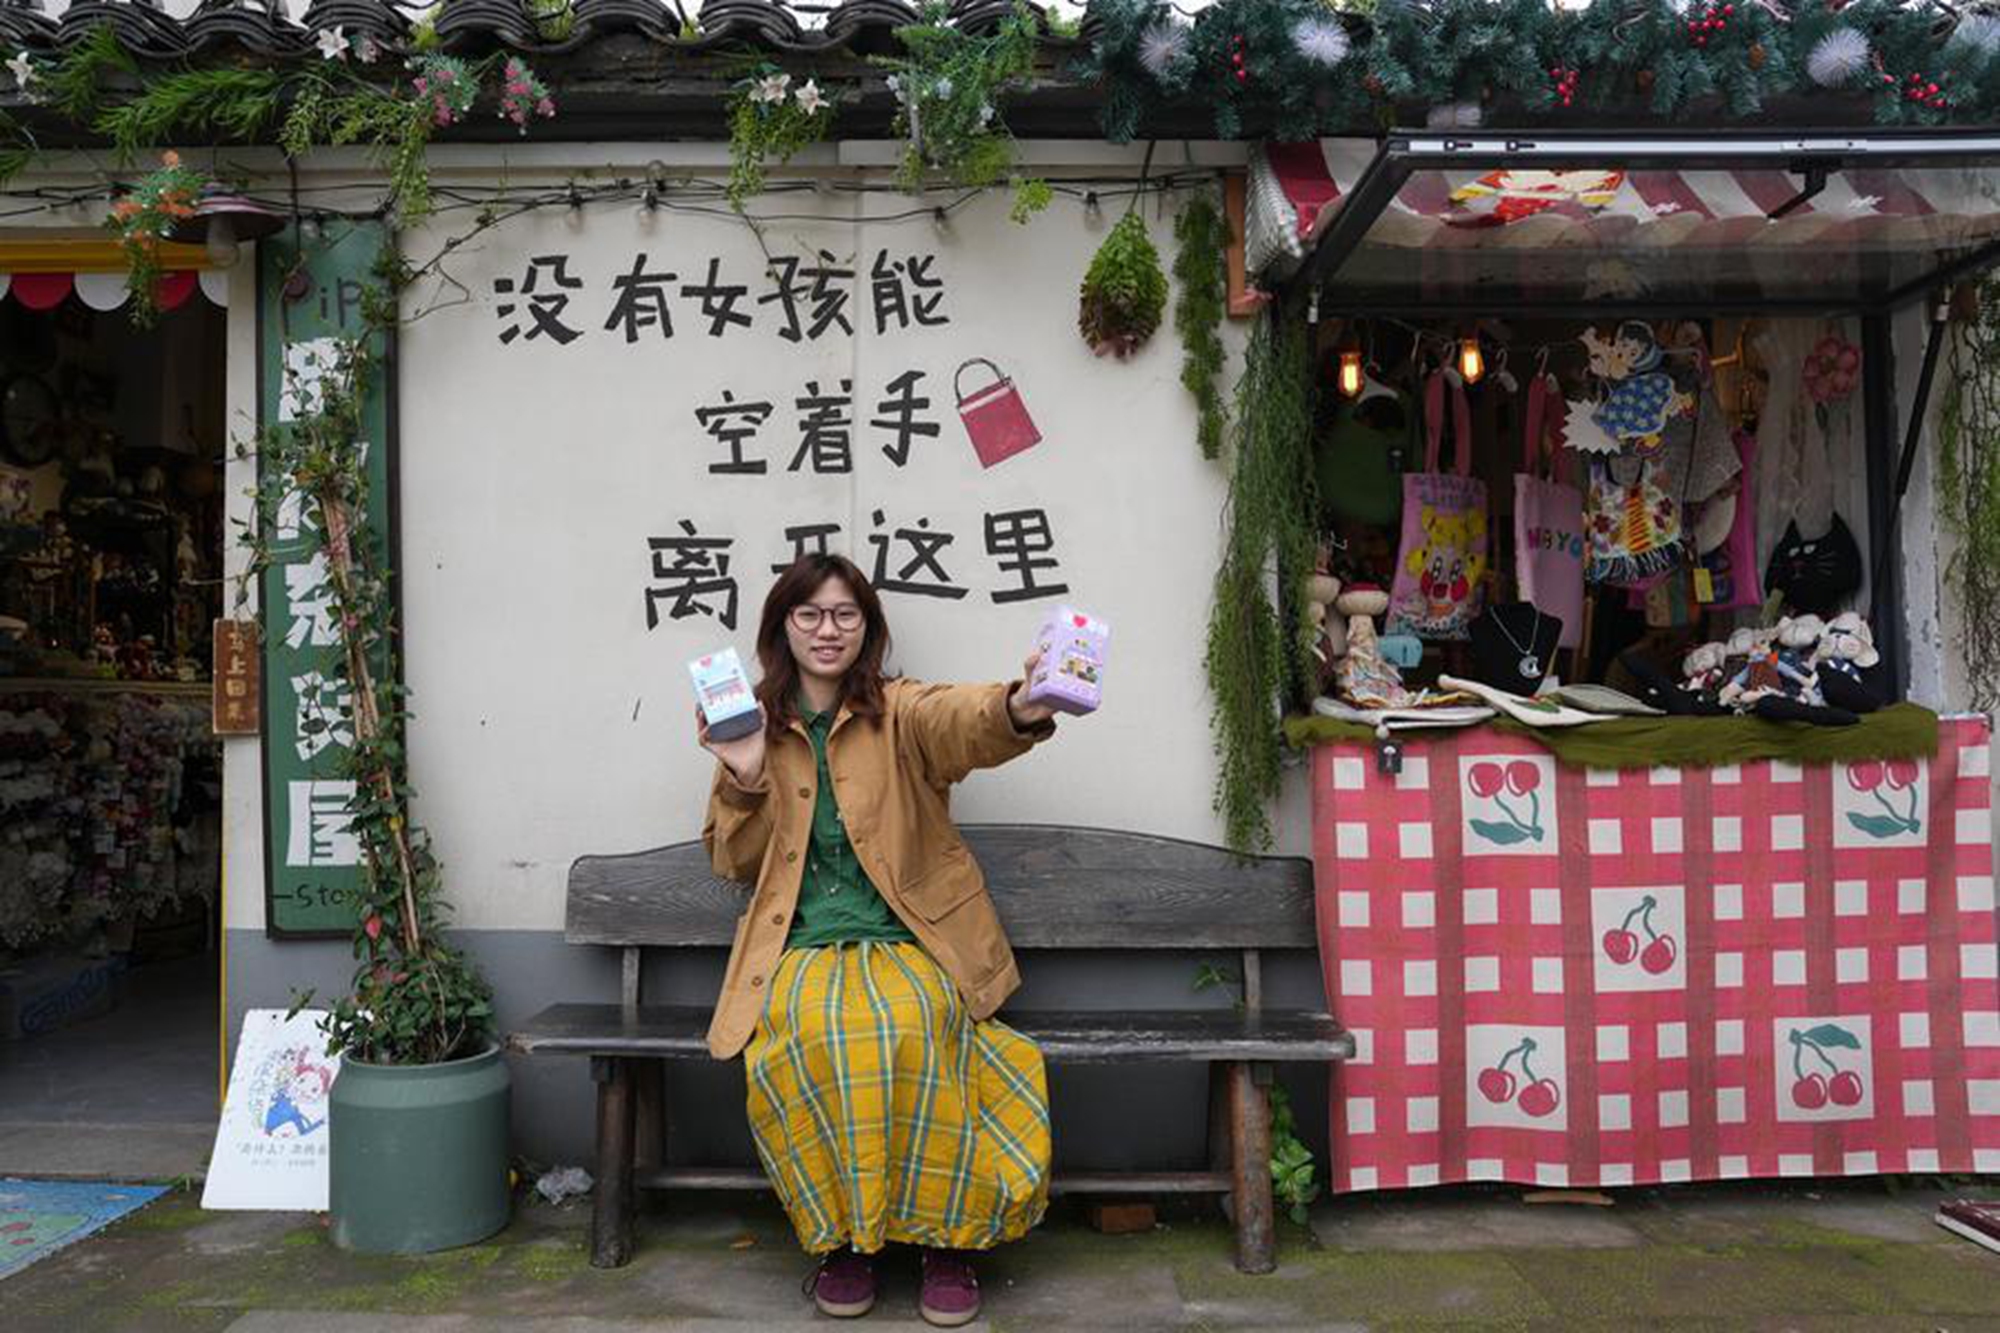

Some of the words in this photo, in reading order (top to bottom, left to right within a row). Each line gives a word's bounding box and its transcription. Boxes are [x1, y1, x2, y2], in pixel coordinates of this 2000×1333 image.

[494, 249, 950, 345] 没有女孩能
[694, 370, 941, 475] 空着手
